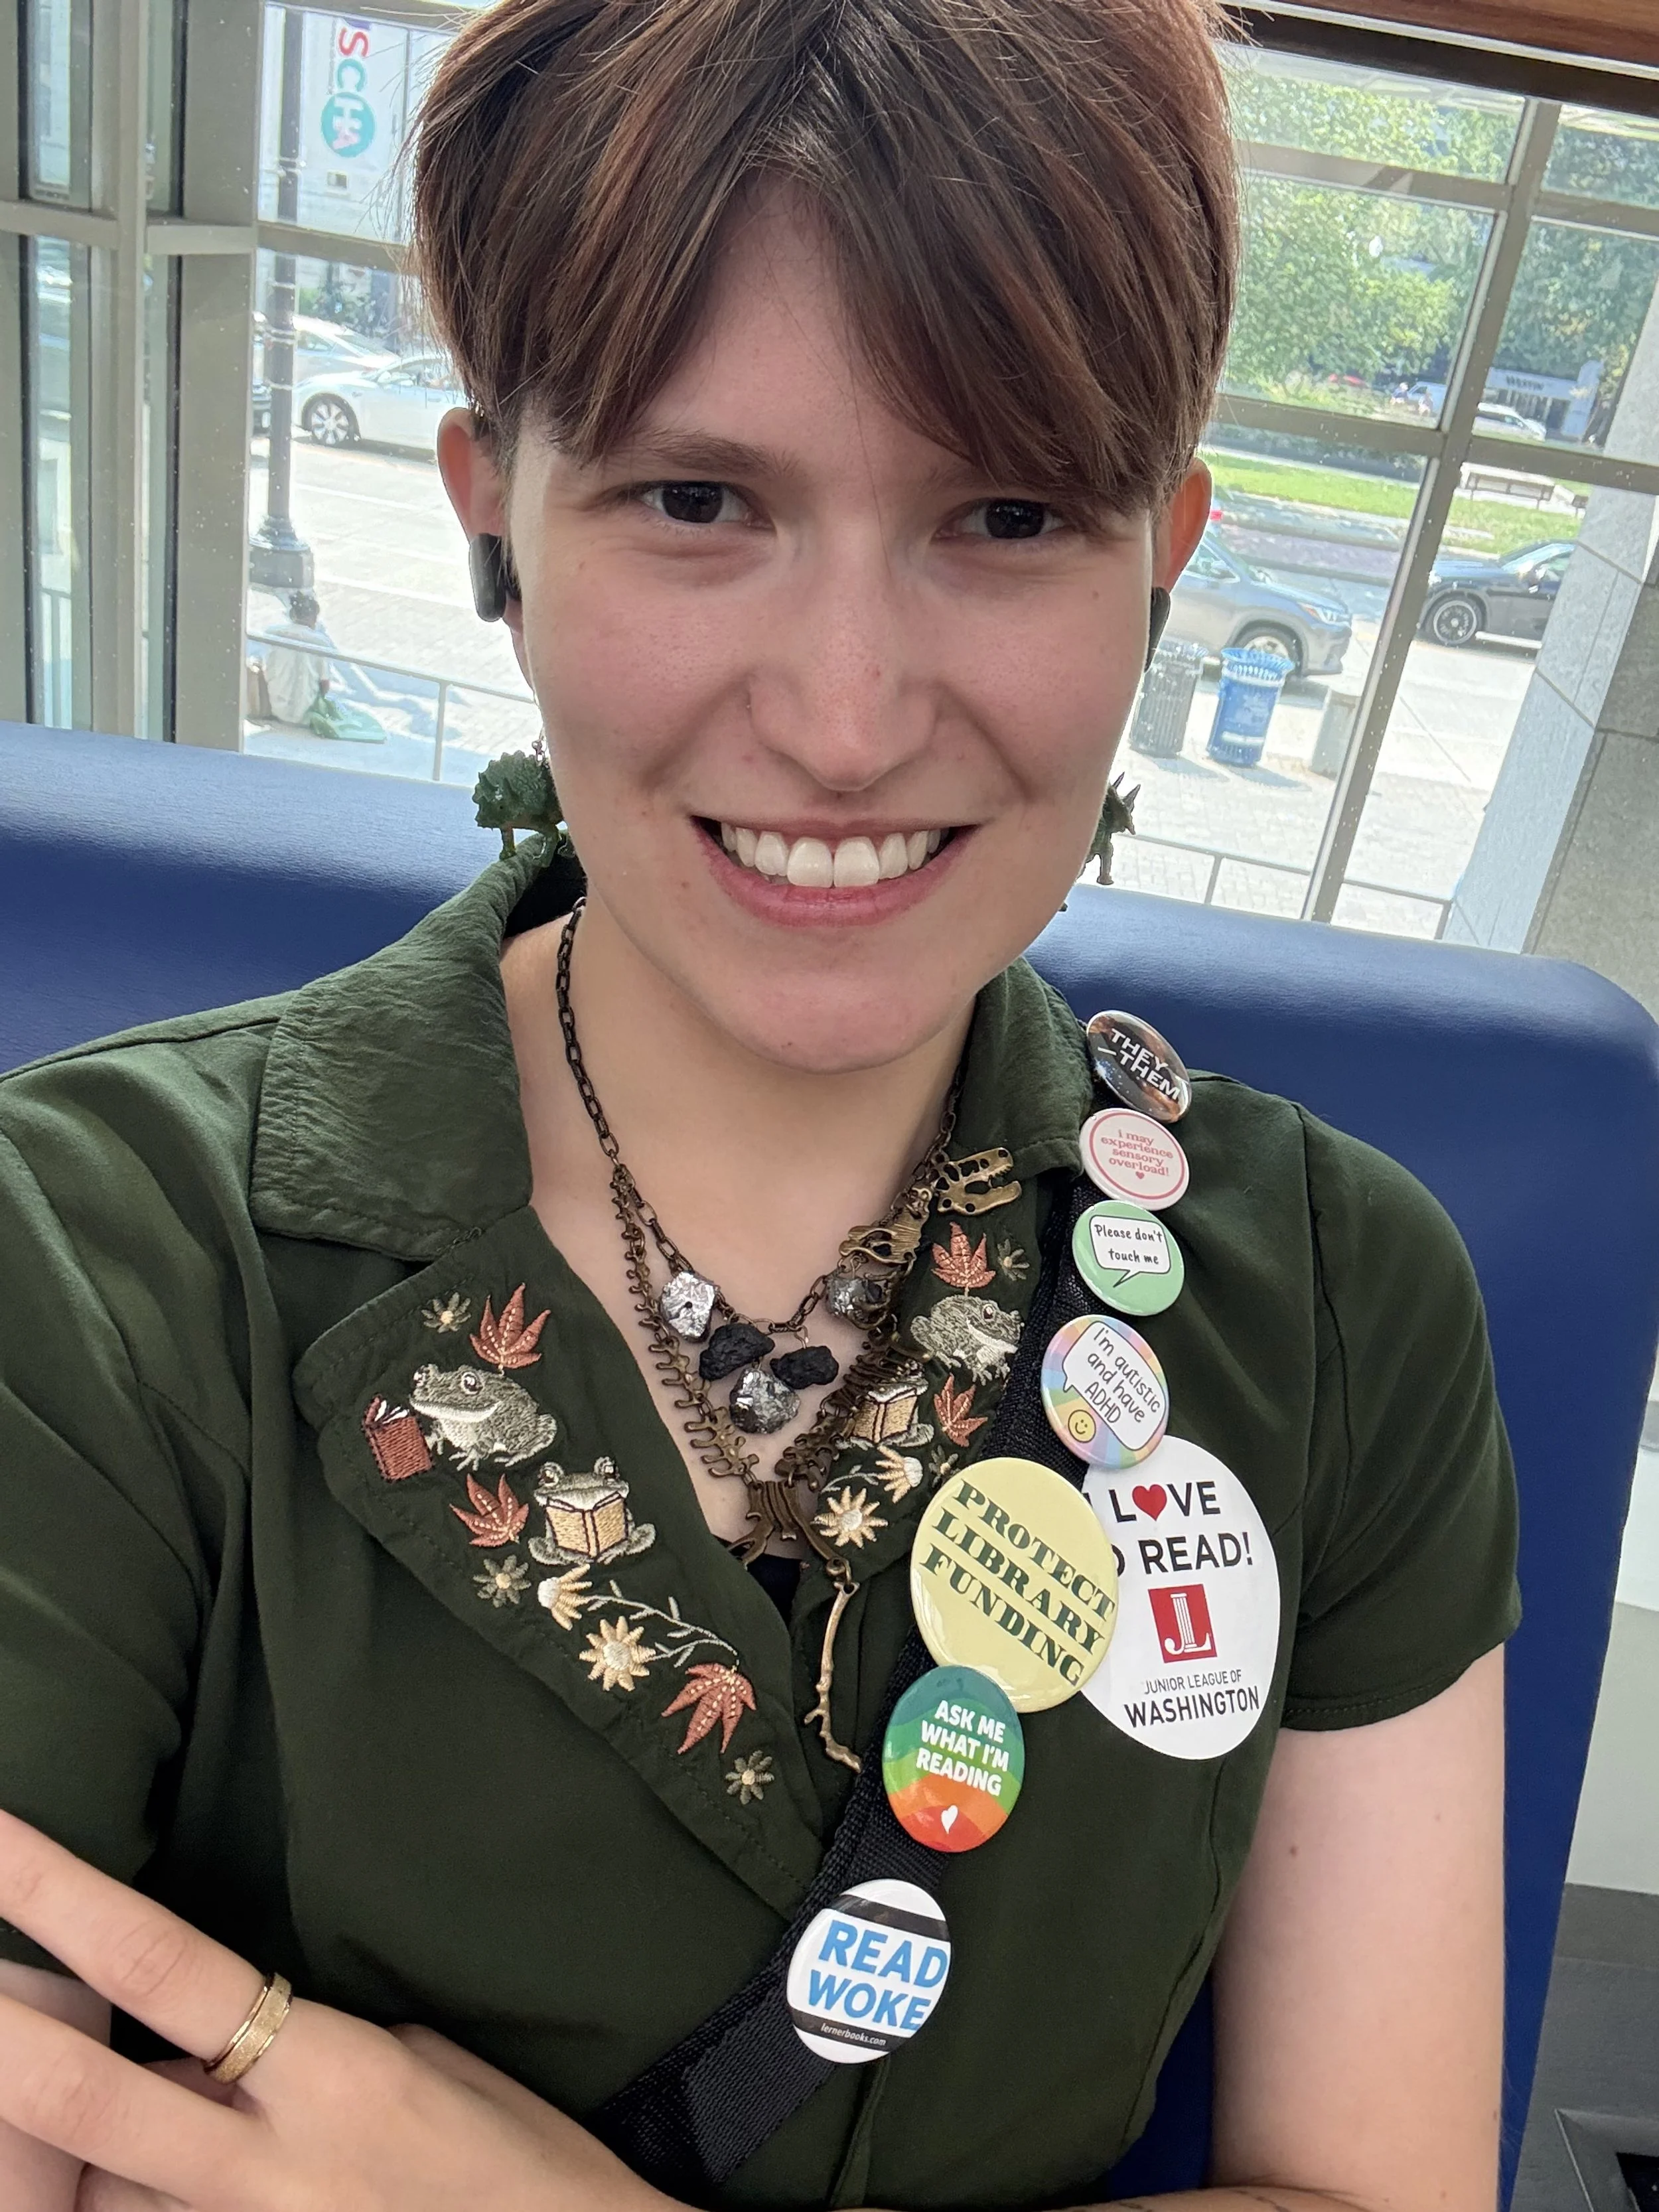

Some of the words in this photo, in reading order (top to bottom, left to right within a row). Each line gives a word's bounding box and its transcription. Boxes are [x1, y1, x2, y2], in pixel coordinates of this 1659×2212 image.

[1112, 1028, 1168, 1071] THEY
[1119, 1050, 1181, 1100] THEM
[1101, 1136, 1173, 1158] experience
[1112, 1148, 1163, 1167] sensory
[1126, 1132, 1154, 1146] may
[1109, 1157, 1169, 1176] overload!
[1094, 1224, 1131, 1239] Please
[1135, 1228, 1163, 1242] don't
[1108, 1248, 1140, 1263] touch
[1143, 1254, 1159, 1264] me
[1088, 1353, 1118, 1385] and
[1113, 1380, 1145, 1423] have
[1094, 1327, 1114, 1357] I'm
[1115, 1357, 1161, 1413] autistic
[1084, 1382, 1121, 1424] ADHD
[952, 1478, 1116, 1623] PROTECT
[1138, 1532, 1254, 1575] READ!
[932, 1506, 1106, 1655] LIBRARY
[920, 1543, 1085, 1686] FUNDING
[1144, 1676, 1186, 1694] JUNIOR
[1187, 1670, 1228, 1688] LEAGUE
[1230, 1669, 1242, 1683] OF
[934, 1700, 975, 1732] ASK
[977, 1715, 1006, 1743] ME
[1124, 1685, 1260, 1729] WASHINGTON
[921, 1720, 981, 1759] WHAT
[981, 1743, 1009, 1772] I'M
[916, 1747, 1002, 1797] READING
[818, 1919, 948, 1988] READ
[808, 1969, 932, 2031] WOKE
[820, 2022, 887, 2046] lernerbooks.com
